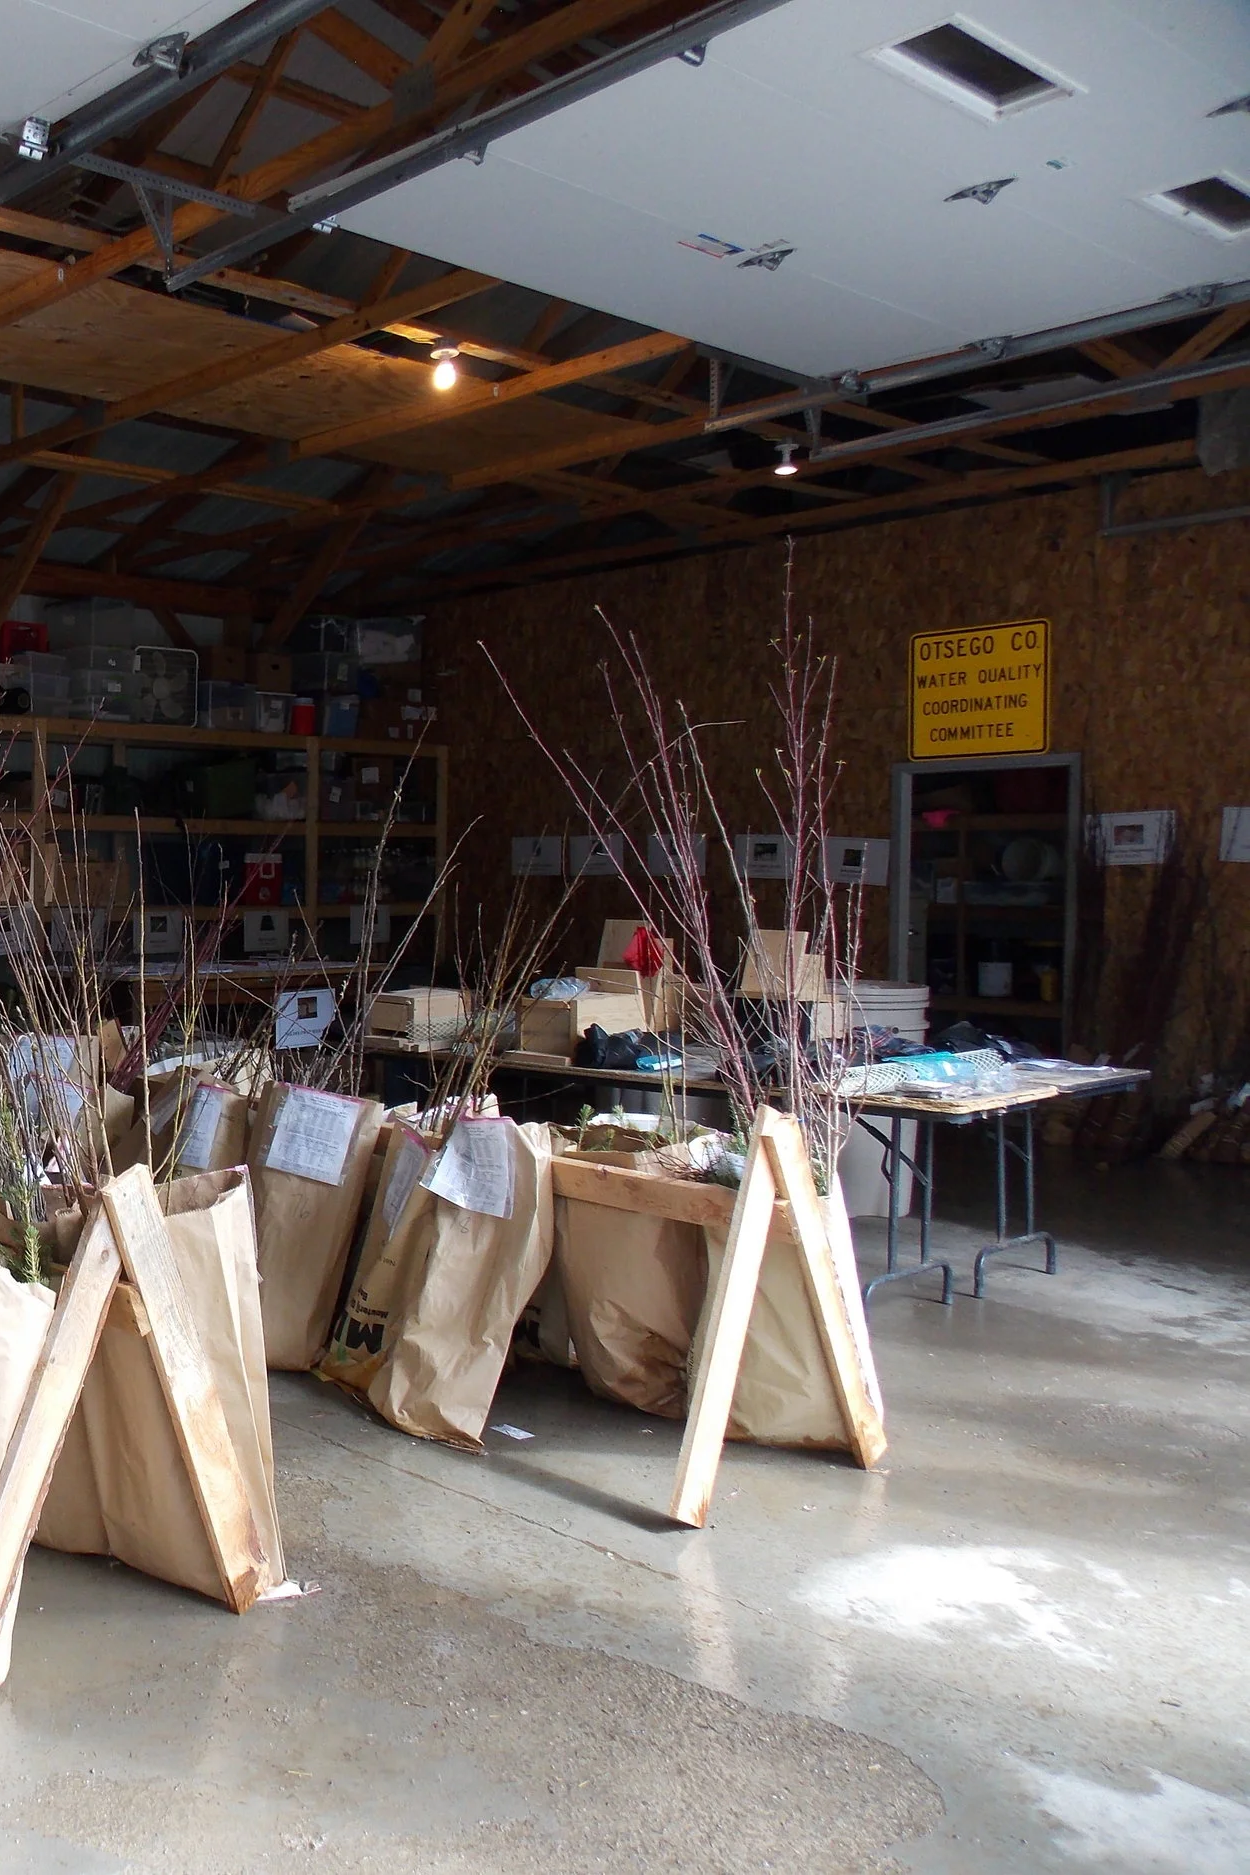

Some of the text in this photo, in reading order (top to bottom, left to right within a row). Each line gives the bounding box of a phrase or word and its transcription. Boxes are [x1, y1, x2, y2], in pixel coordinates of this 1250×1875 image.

[919, 635, 994, 661] OTSEGO
[916, 663, 1042, 689] WATER QUALITY
[922, 693, 1028, 716] COORDINATING
[929, 722, 1014, 742] COMMITTEE
